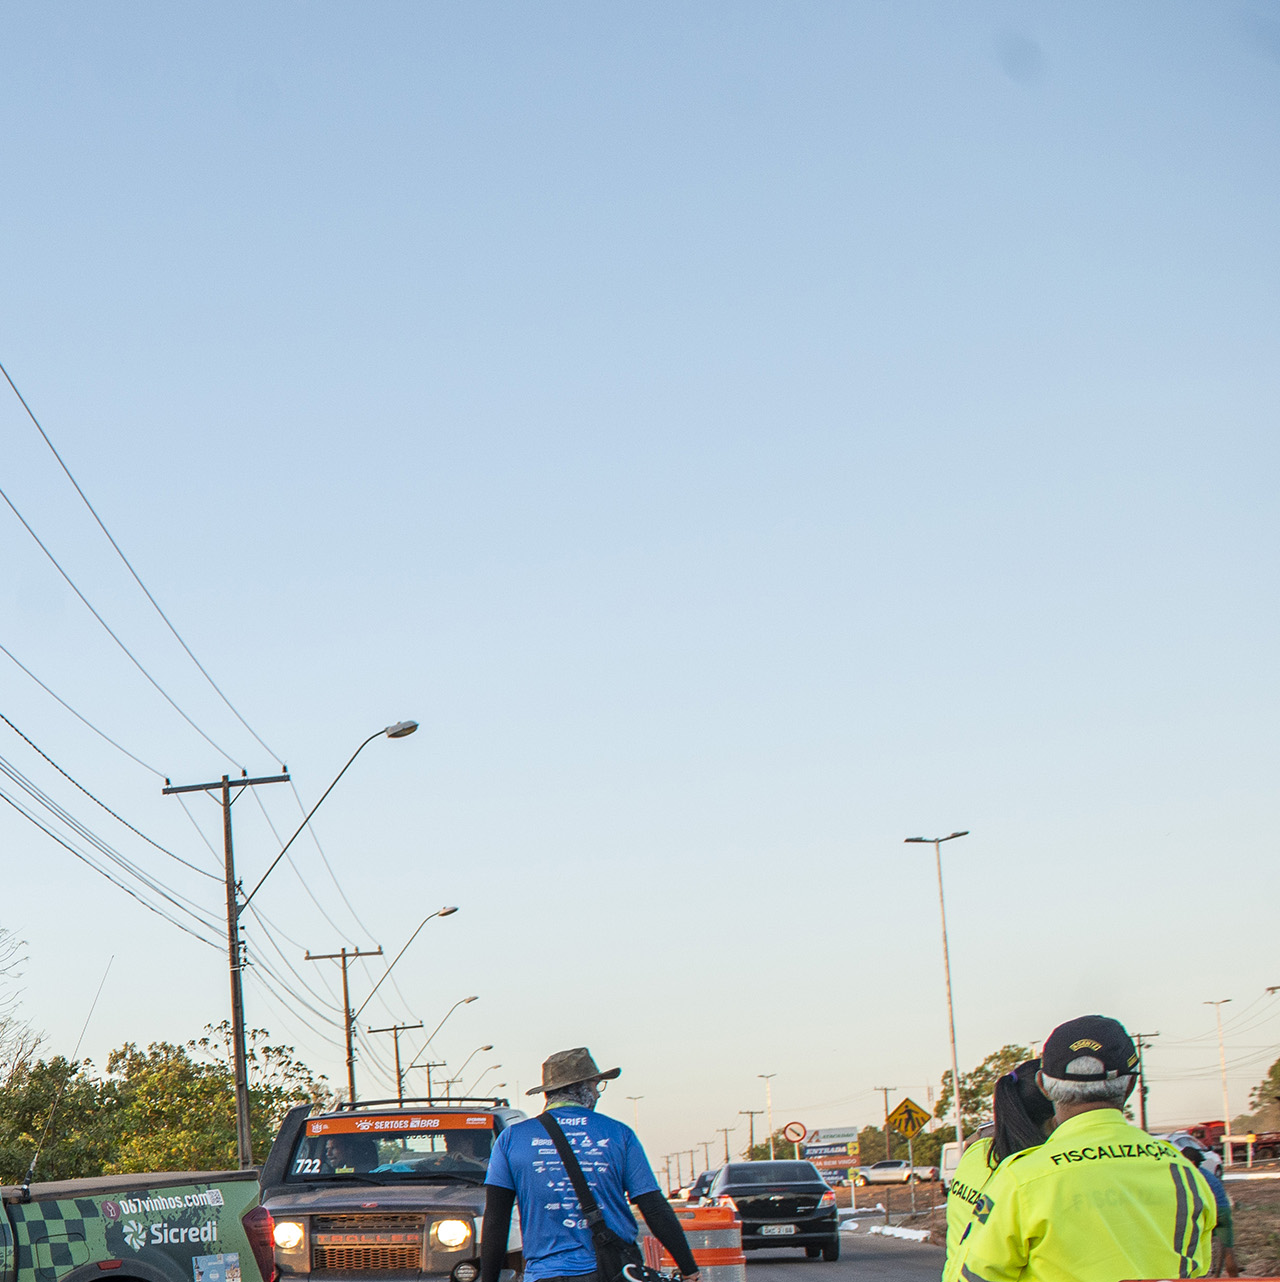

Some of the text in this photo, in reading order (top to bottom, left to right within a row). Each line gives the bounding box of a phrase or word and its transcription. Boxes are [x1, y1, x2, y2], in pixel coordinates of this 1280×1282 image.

[420, 1119, 440, 1128] BRB
[806, 1146, 847, 1155] ENTRADA
[1051, 1141, 1178, 1165] FISCALIZAÇÃO
[295, 1159, 321, 1174] 722
[119, 1192, 209, 1215] 067vinhos.com
[151, 1220, 218, 1245] Sicredi
[317, 1234, 419, 1242] TROLLER
